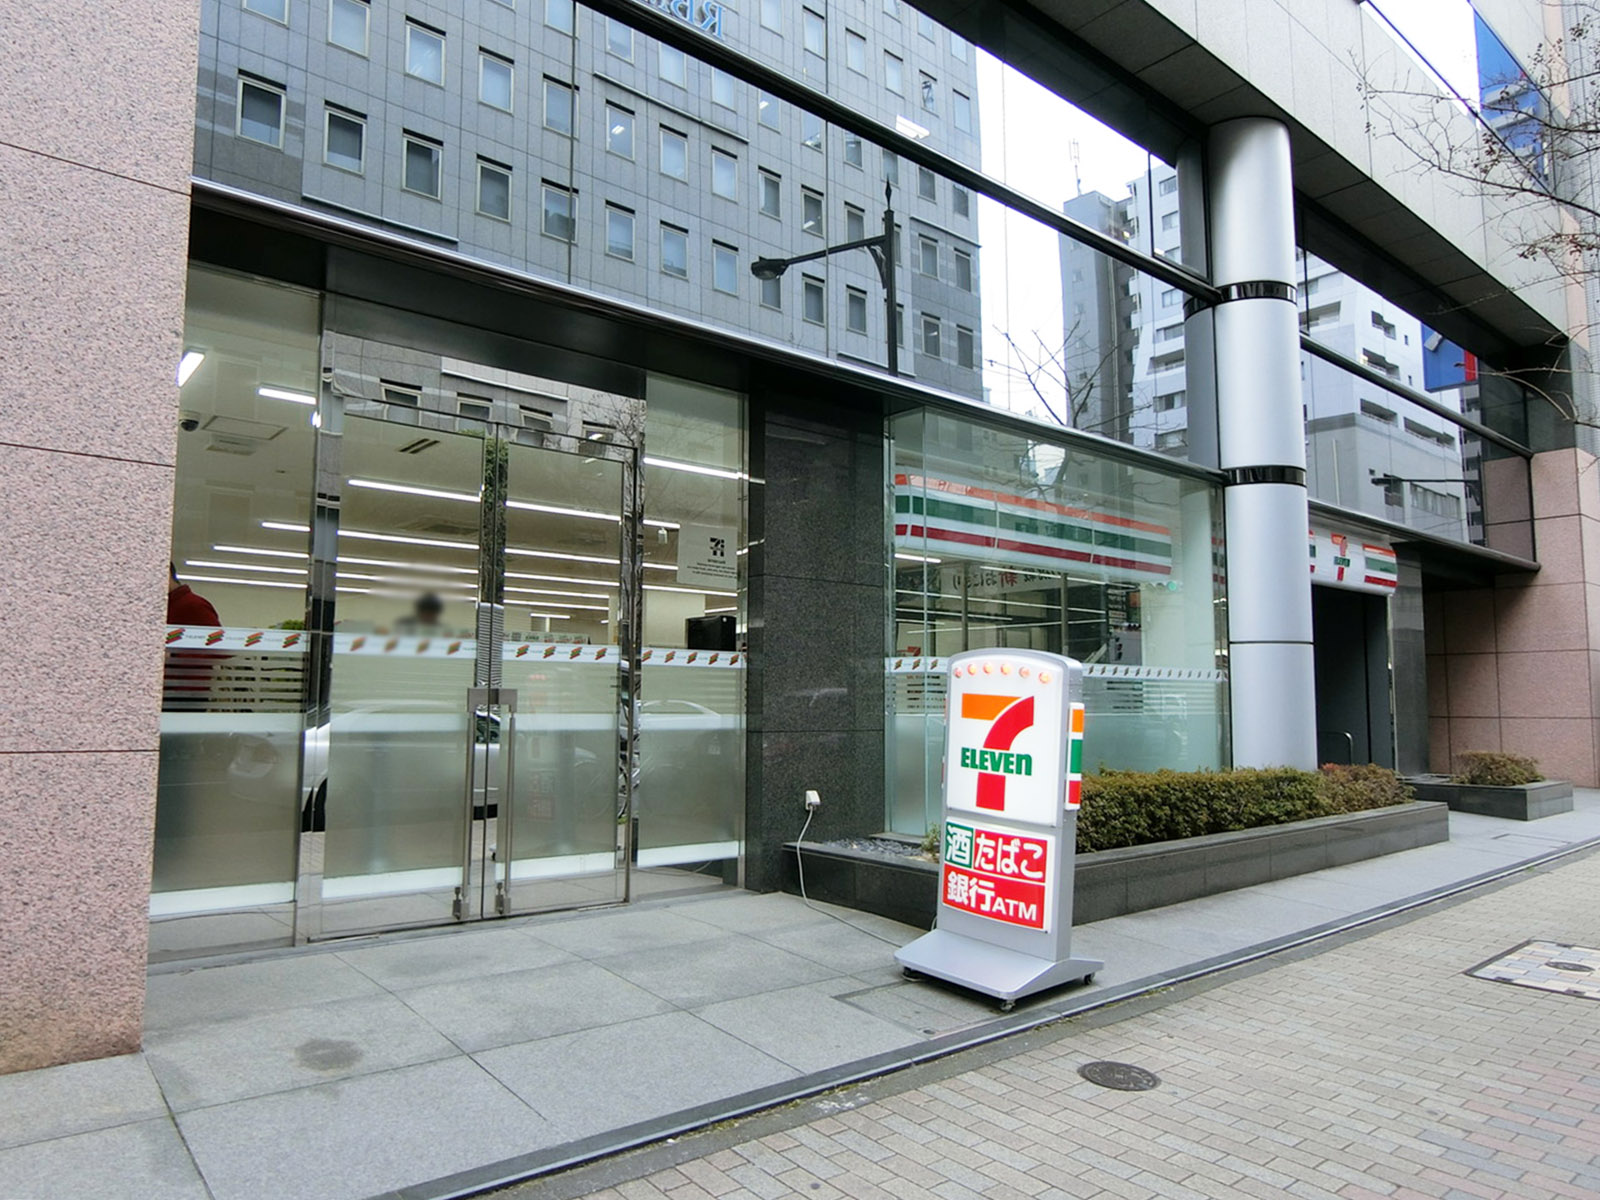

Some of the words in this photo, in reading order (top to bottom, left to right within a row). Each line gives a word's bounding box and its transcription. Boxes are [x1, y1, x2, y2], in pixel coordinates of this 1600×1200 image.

[946, 825, 973, 866] 酒
[974, 833, 1044, 879] たばこ
